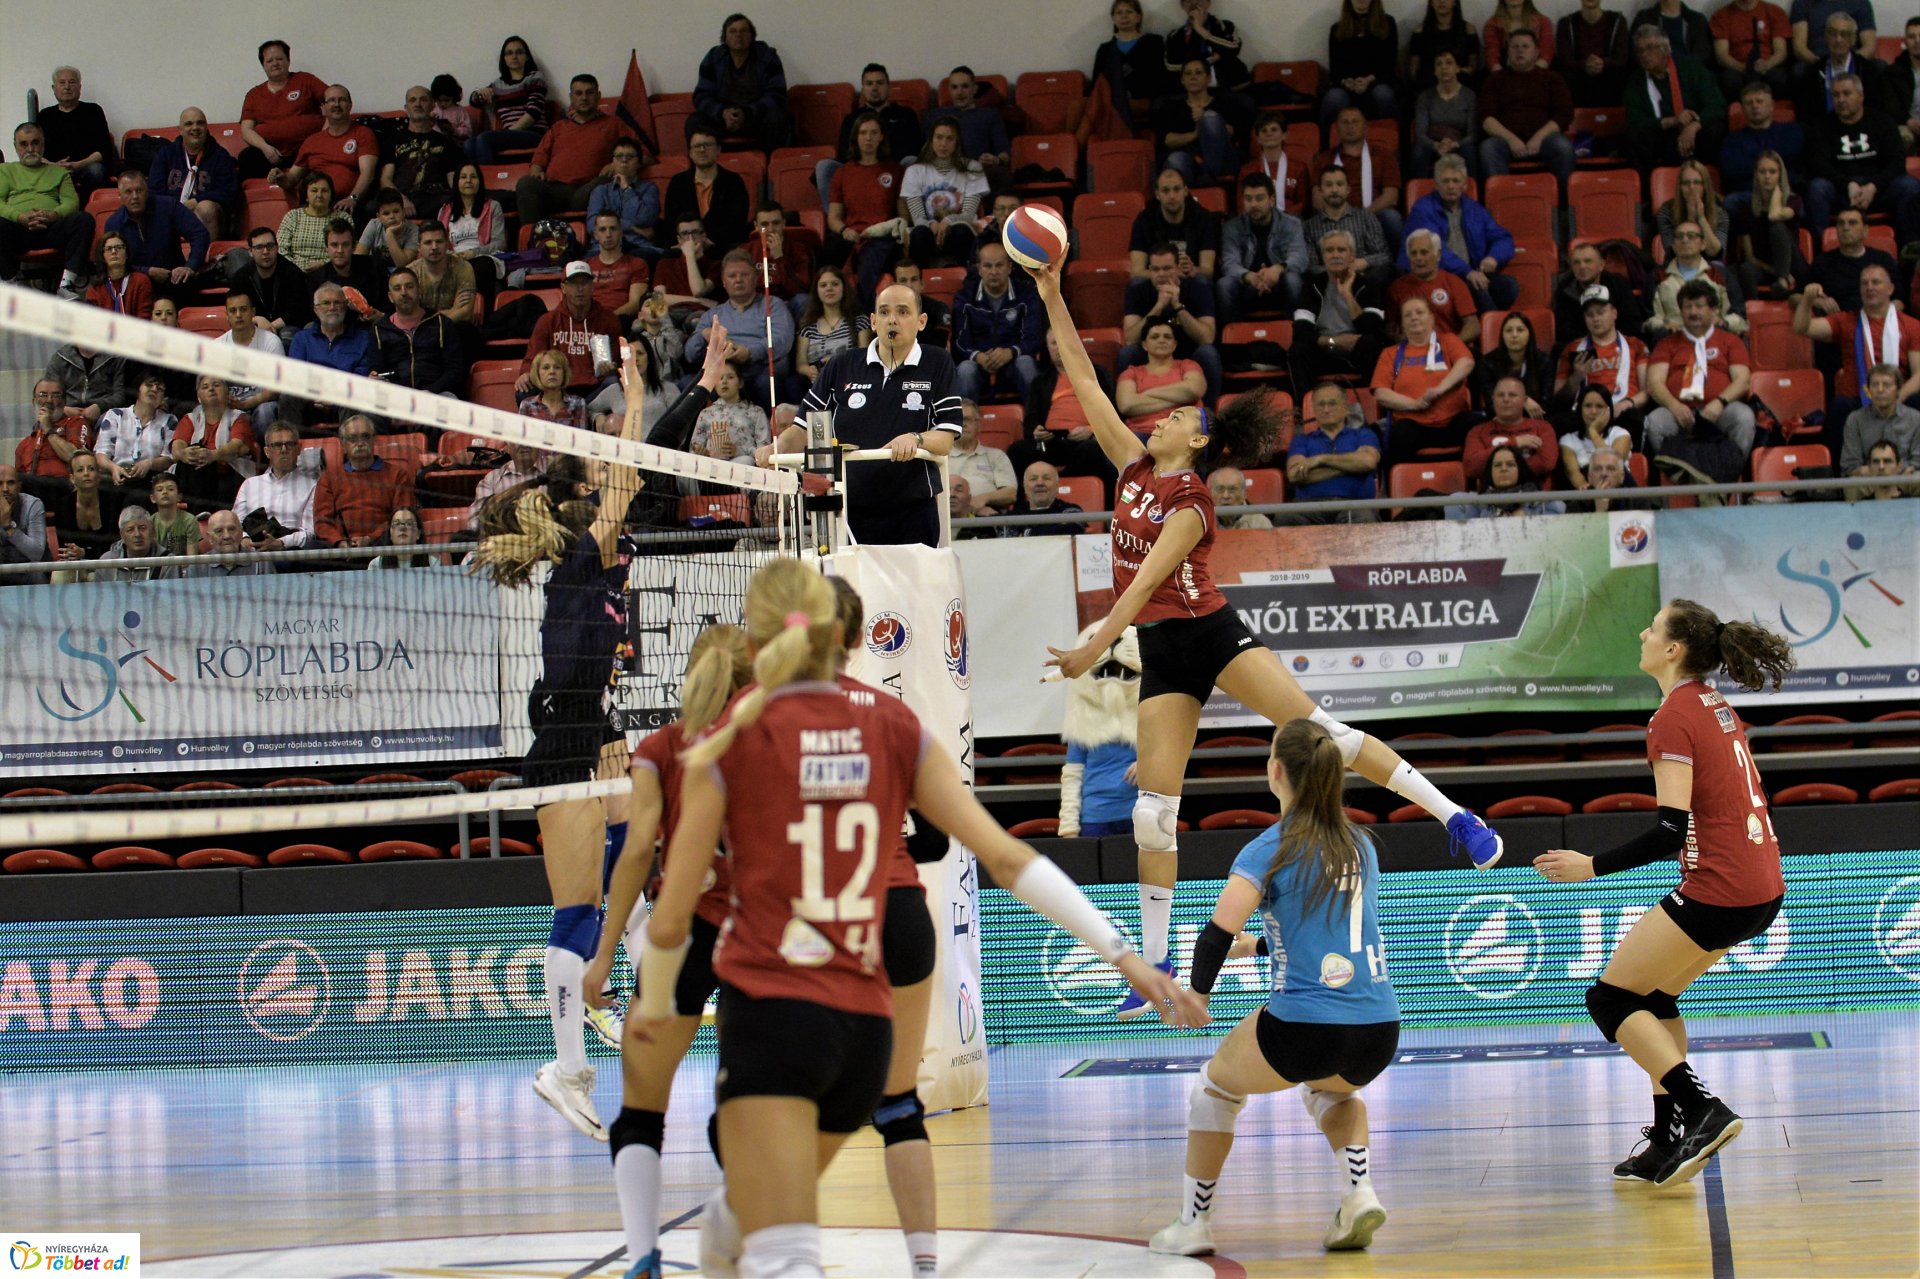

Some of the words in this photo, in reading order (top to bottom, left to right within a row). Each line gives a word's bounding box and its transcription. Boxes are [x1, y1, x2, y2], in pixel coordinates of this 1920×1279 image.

[167, 168, 211, 191] GP
[1130, 493, 1154, 518] 3
[1269, 573, 1310, 582] 2018-2019
[1368, 567, 1468, 586] RÖPLABDA
[264, 618, 340, 635] MAGYAR
[866, 612, 891, 638] FATUM
[1237, 601, 1299, 635] NŐI
[1306, 599, 1500, 633] EXTRALIGA
[196, 639, 415, 679] RÖPLABDA
[1851, 673, 1891, 684] hunvolley
[256, 681, 353, 703] SZÖVETSÉG
[1406, 691, 1436, 701] magyar
[1438, 687, 1474, 697] röplabda
[1476, 684, 1518, 695] szövetség
[1539, 683, 1614, 694] www.hunvolley.hu
[1335, 694, 1377, 705] Hunvolley
[257, 743, 286, 752] magyar
[287, 740, 322, 750] röplabda
[324, 738, 363, 748] szövetség
[384, 734, 455, 744] www.hunvolley.hu
[125, 746, 163, 757] hunvolley
[191, 744, 230, 754] Hunvolley
[804, 760, 864, 781] FATUM
[1733, 739, 1765, 808] 2
[787, 802, 879, 922] 12
[557, 985, 571, 1019] MIKASA
[950, 1049, 982, 1068] NYÍREGYHÁZA
